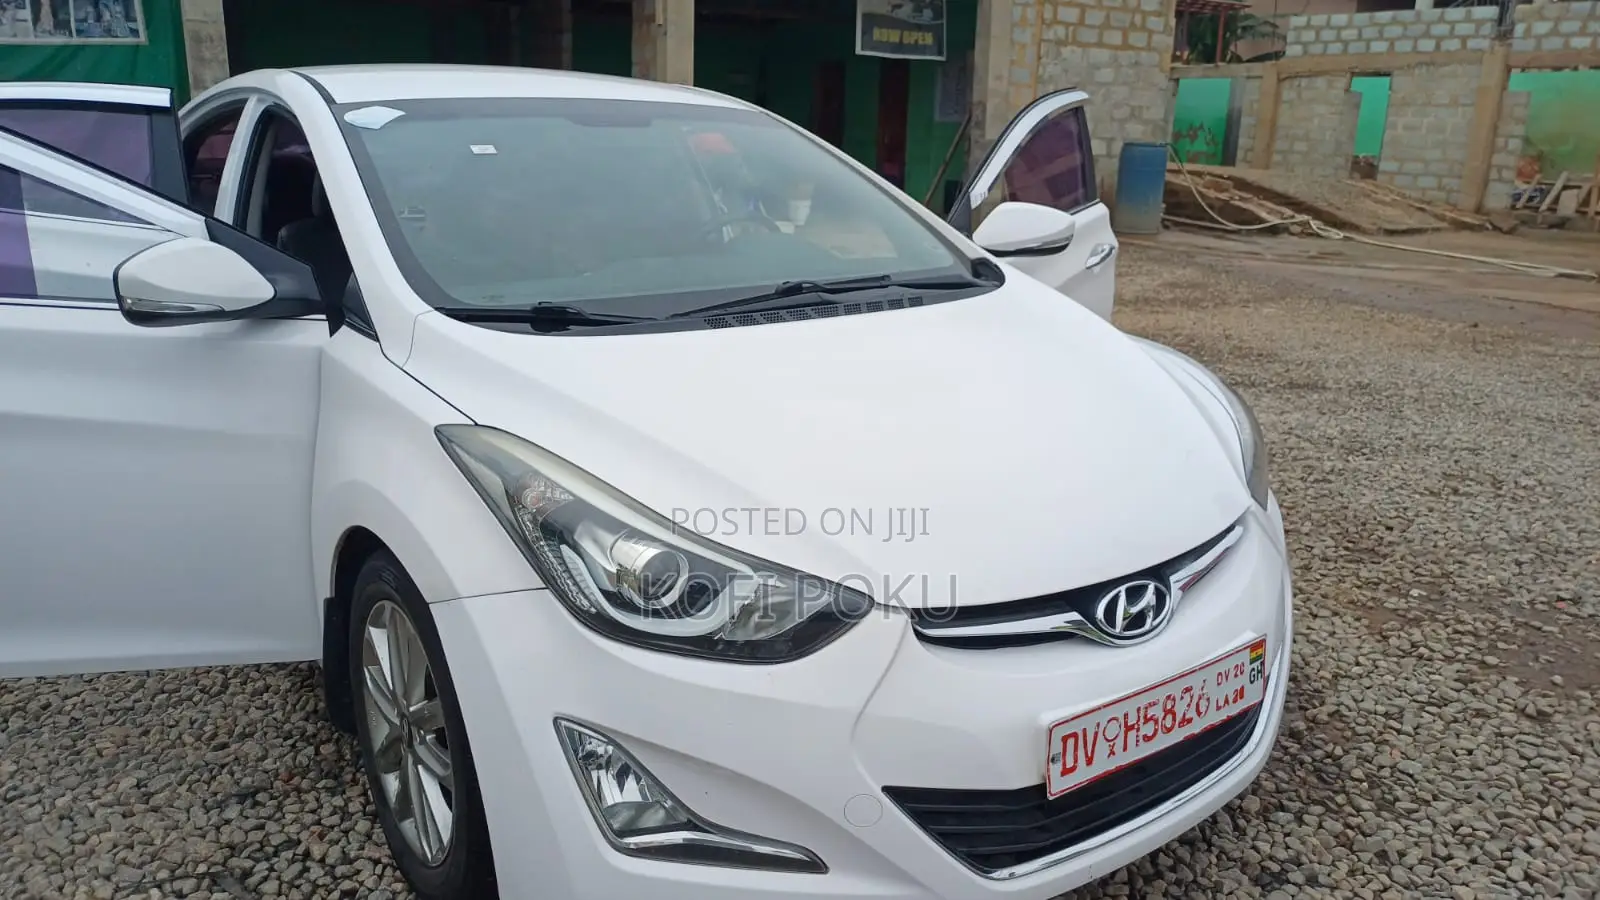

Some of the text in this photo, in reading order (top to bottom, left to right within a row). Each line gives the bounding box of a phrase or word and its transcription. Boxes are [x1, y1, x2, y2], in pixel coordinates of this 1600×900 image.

[902, 30, 934, 46] OPEN
[1217, 668, 1230, 686] DV
[1249, 660, 1263, 685] GH
